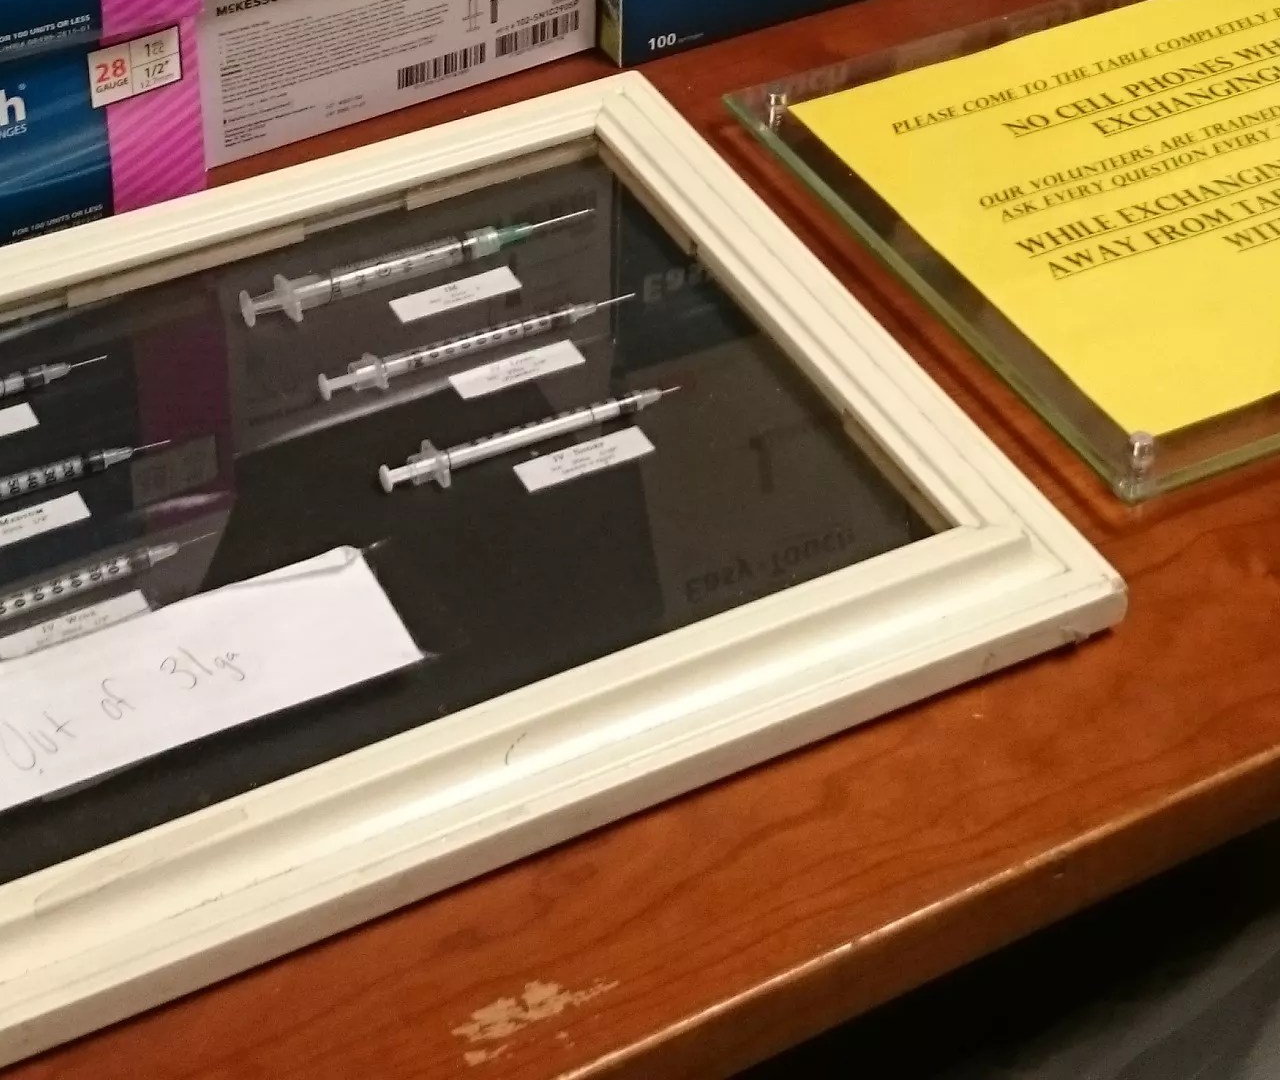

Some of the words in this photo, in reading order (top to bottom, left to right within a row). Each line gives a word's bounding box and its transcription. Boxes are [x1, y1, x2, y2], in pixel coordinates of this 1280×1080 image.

[94, 57, 128, 84] 28
[891, 106, 959, 135] PLEASE
[962, 89, 1019, 114] COME
[1019, 78, 1048, 95] TO
[1051, 66, 1090, 87] THE
[1094, 47, 1149, 74] TABLE
[1155, 10, 1268, 55] COMPLETELY
[1003, 113, 1050, 137] NO
[1055, 91, 1120, 120] CELL
[1124, 55, 1235, 99] PHONES
[979, 185, 1025, 209] OUR
[1029, 144, 1155, 192] VOLUNTEERS
[1160, 132, 1199, 153] ARE
[1001, 200, 1038, 222] ASK
[1042, 180, 1106, 208] EVERY
[1111, 147, 1208, 188] QUESTION
[1212, 127, 1271, 154] EVERY
[1014, 214, 1118, 257] WHILE
[1047, 236, 1140, 280] AWAY
[1143, 207, 1235, 245] FROM
[99, 678, 137, 721] of
